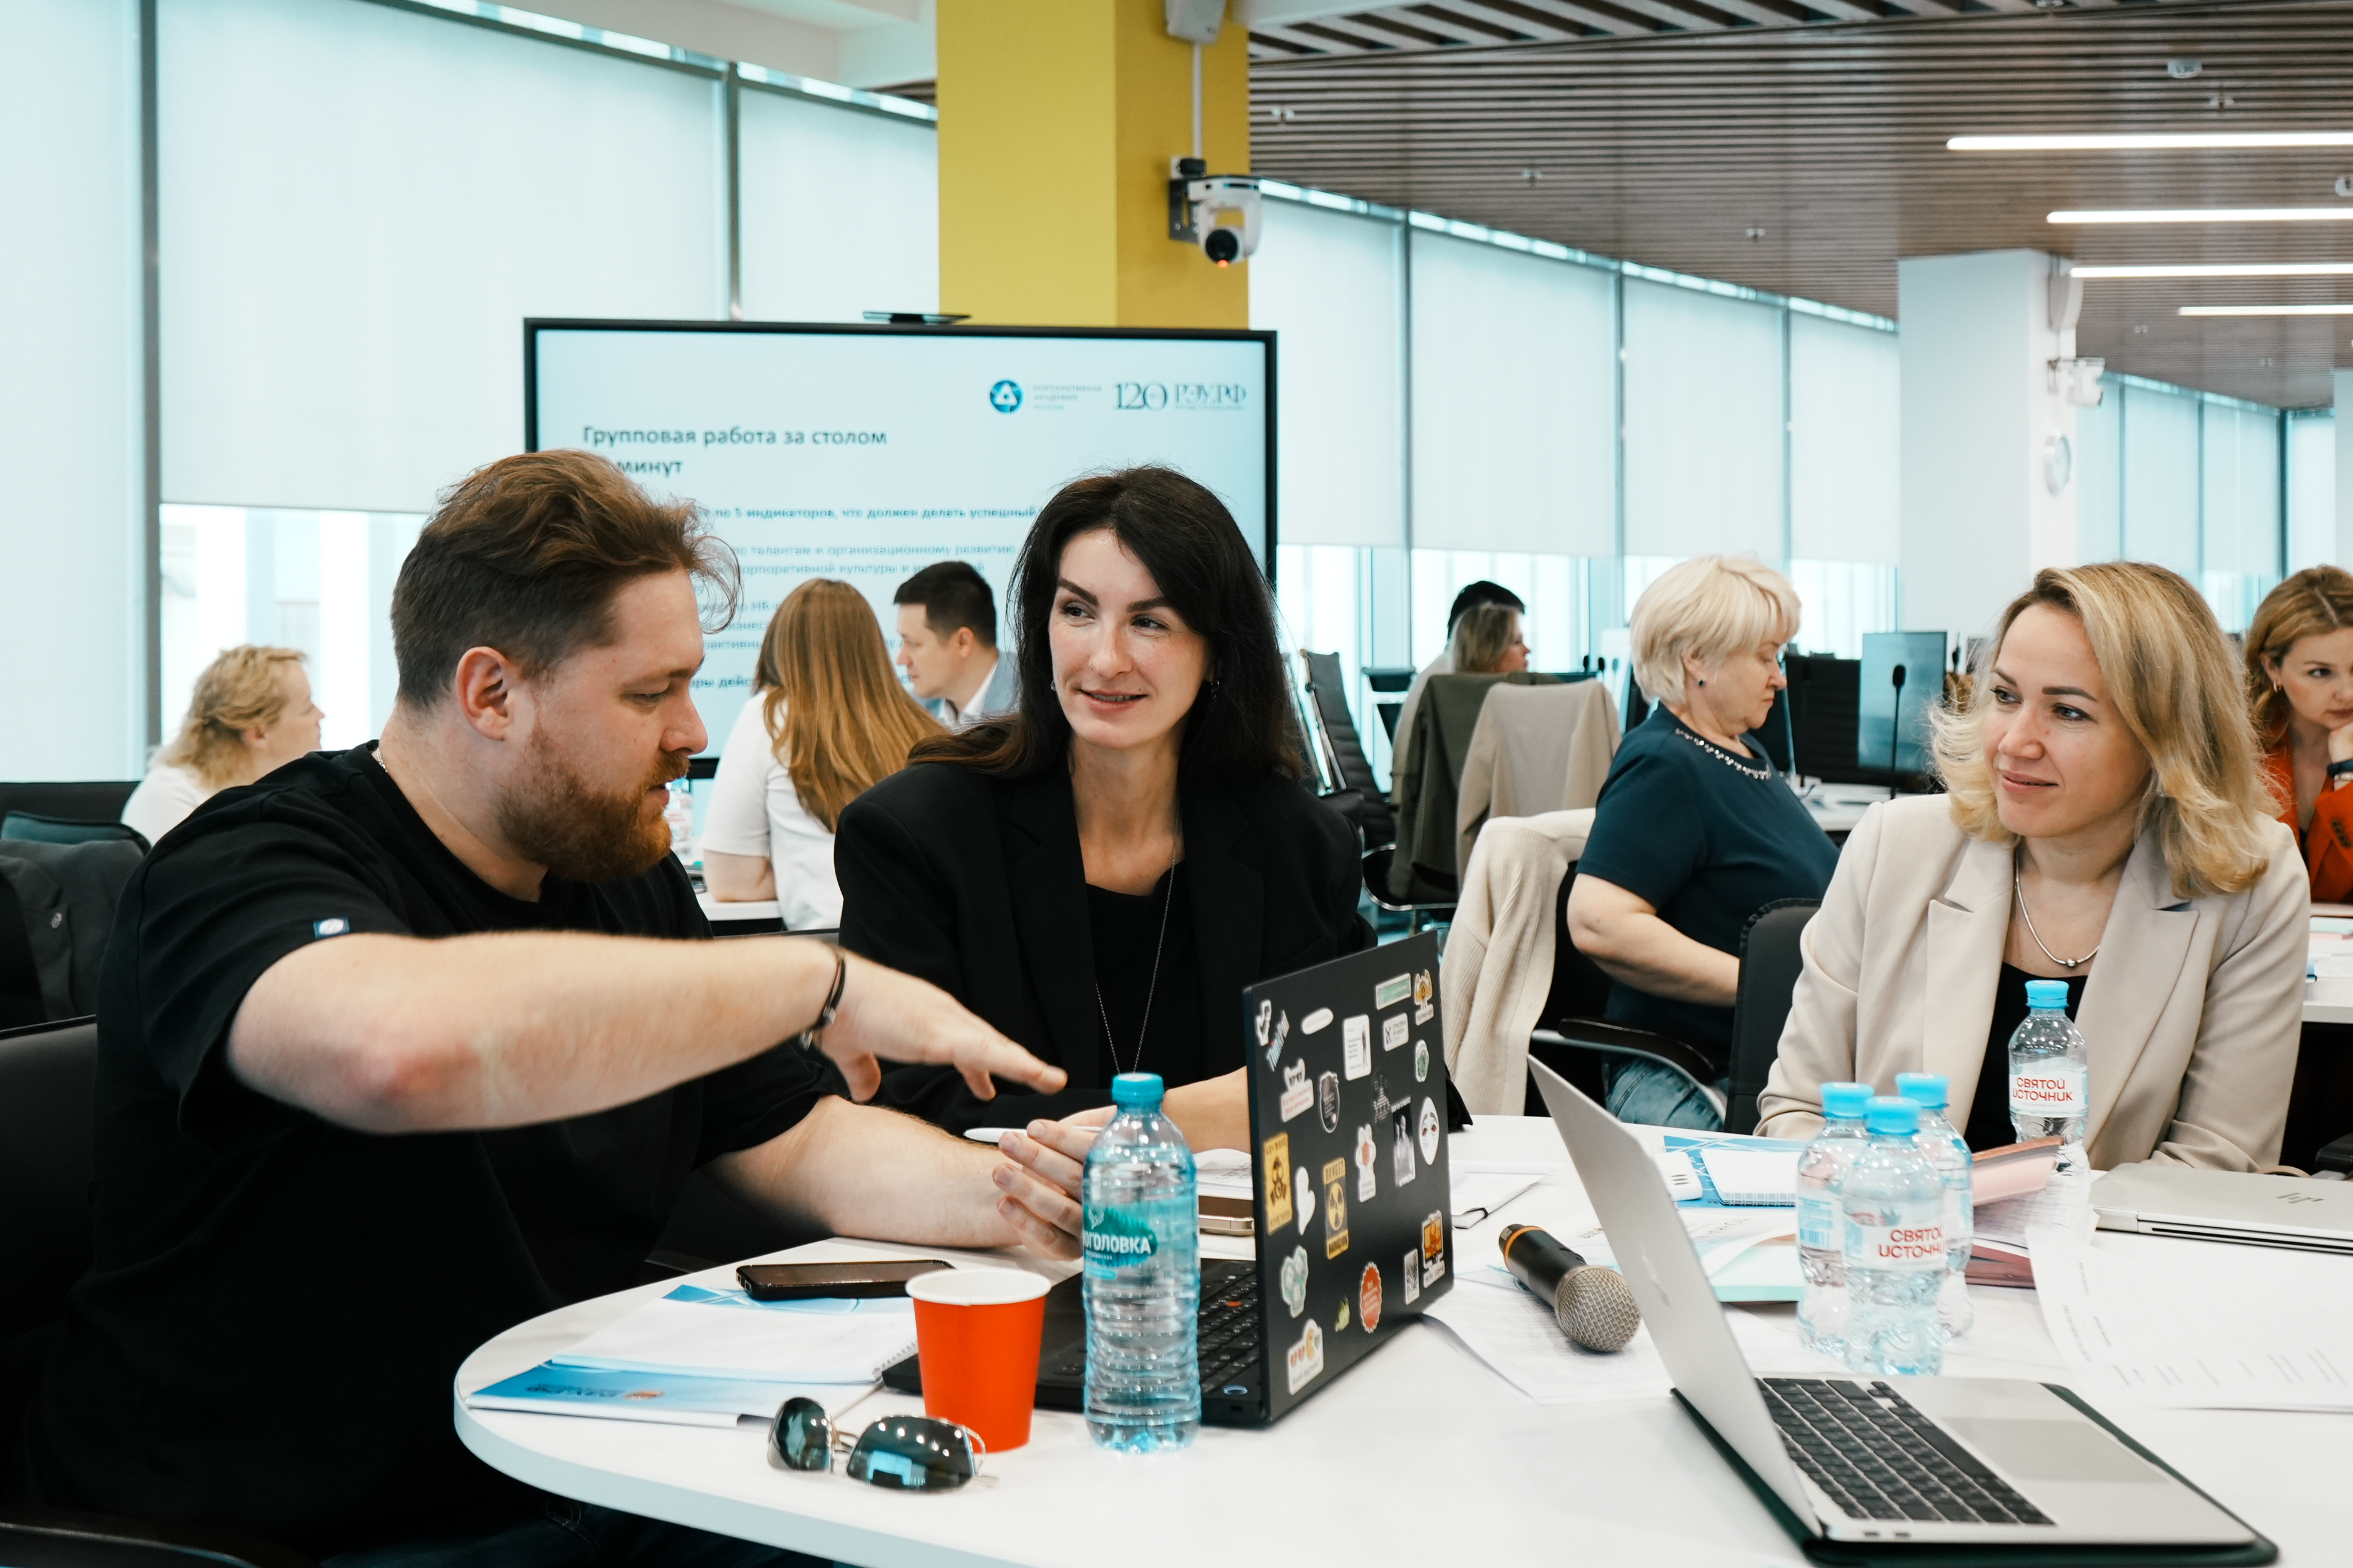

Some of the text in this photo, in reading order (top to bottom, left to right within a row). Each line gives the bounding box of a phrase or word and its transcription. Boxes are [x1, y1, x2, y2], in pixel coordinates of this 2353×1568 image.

[1114, 381, 1168, 411] 120
[583, 426, 887, 447] Групповая работа за столом
[617, 461, 684, 477] минут
[716, 509, 731, 518] по
[747, 509, 838, 520] индикаторов,
[842, 509, 863, 518] что
[867, 509, 918, 519] должен
[922, 509, 967, 519] делать
[970, 506, 1037, 519] успешный
[827, 546, 952, 556] организационному
[956, 546, 1016, 556] развитию
[737, 563, 835, 575] орпоративной
[2017, 1077, 2065, 1090] СВЯТОЙ
[2013, 1088, 2074, 1102] ИСТОЧНИК
